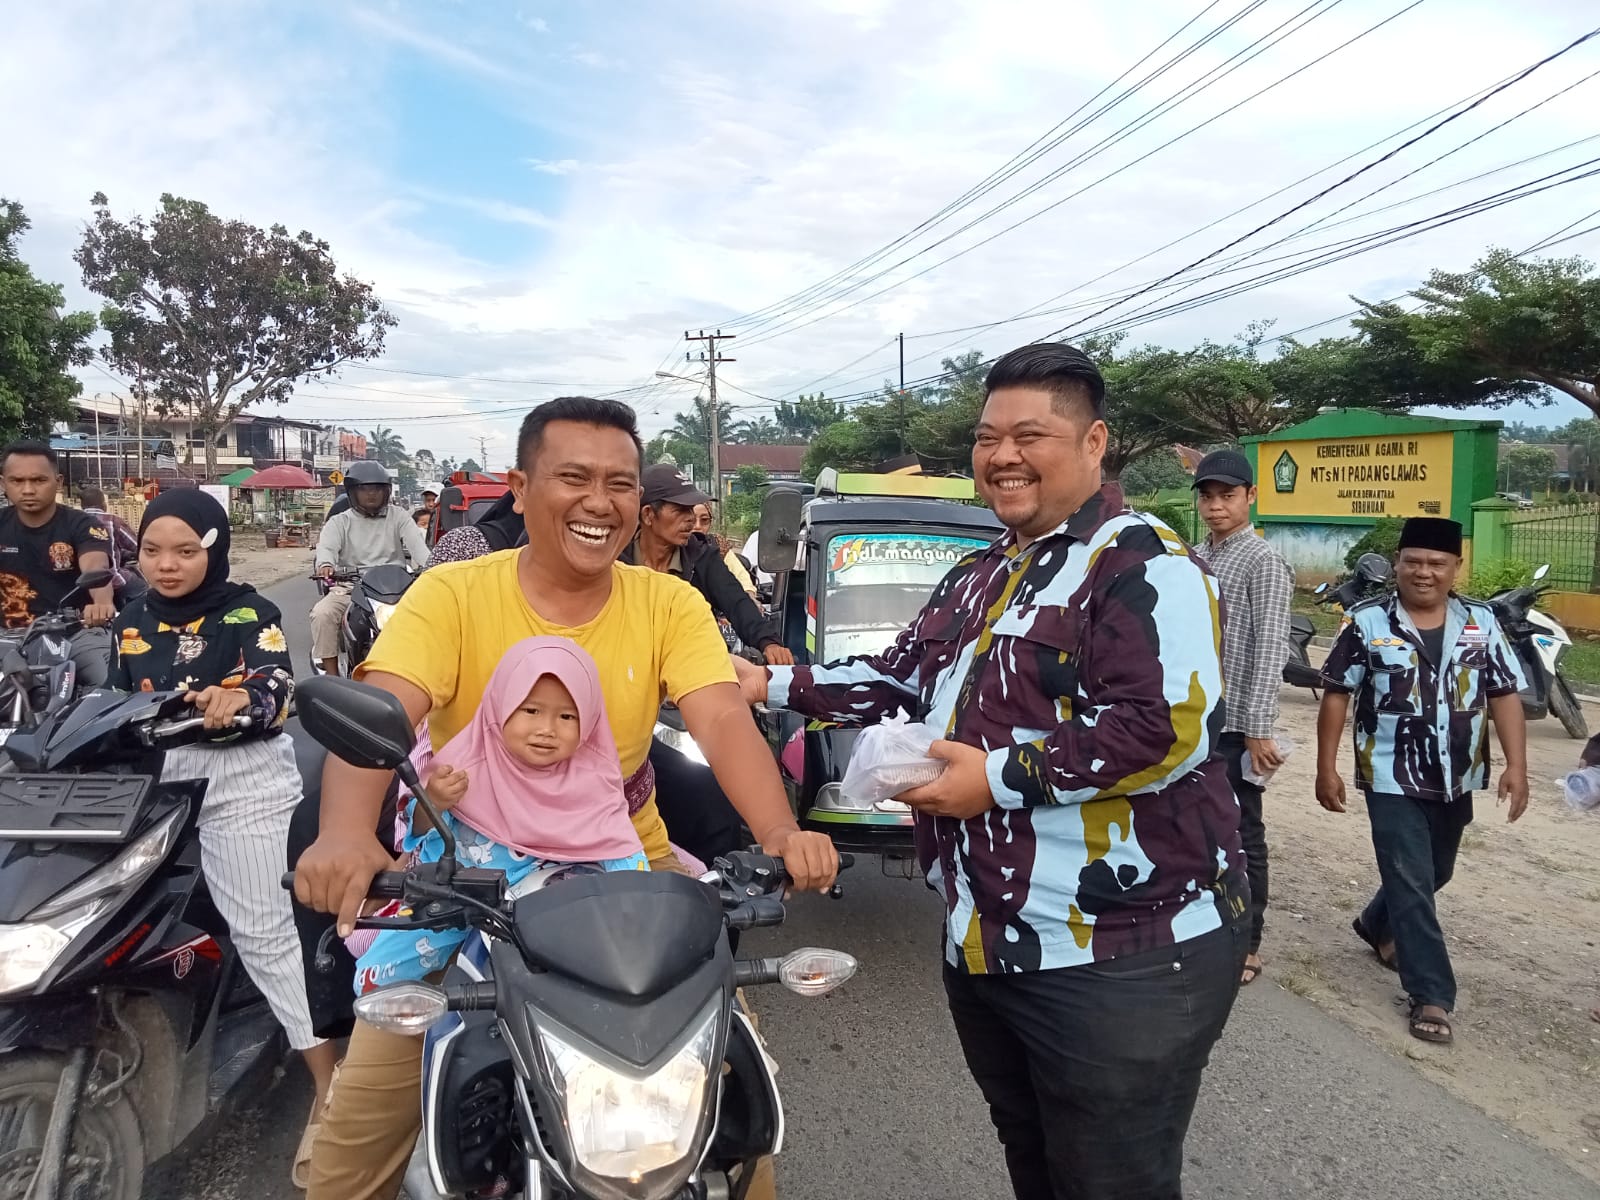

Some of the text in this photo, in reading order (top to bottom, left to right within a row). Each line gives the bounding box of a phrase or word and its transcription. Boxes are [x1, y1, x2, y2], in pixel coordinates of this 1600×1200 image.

[1316, 441, 1418, 459] KEMENTERIAN AGAMA RI
[1351, 500, 1385, 513] SIBUHUAN
